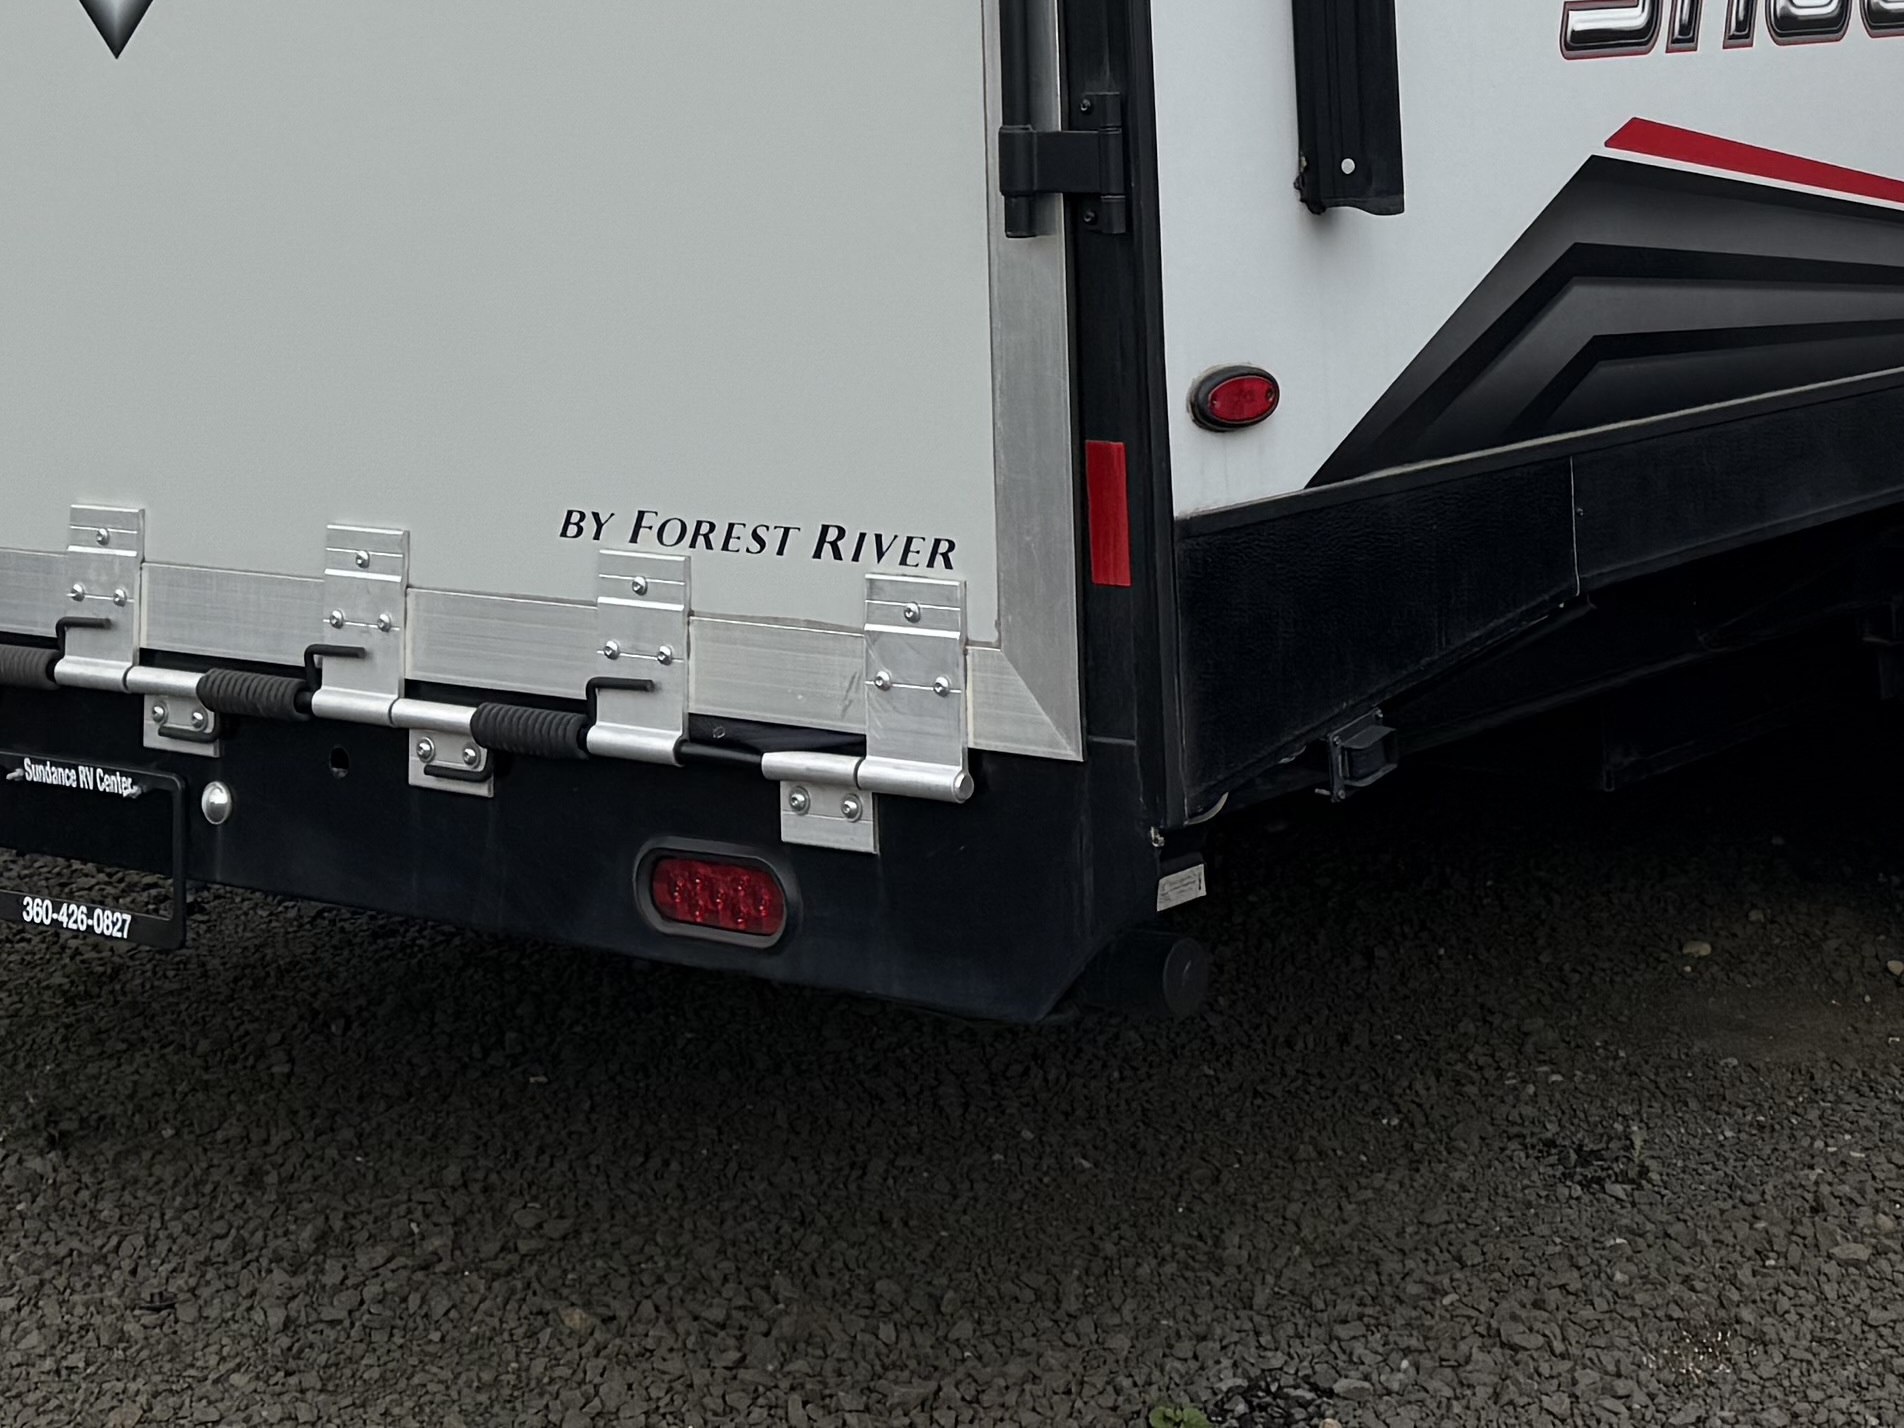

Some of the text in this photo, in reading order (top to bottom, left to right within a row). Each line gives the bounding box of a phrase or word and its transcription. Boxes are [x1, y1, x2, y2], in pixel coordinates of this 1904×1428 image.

[559, 509, 957, 571] BY FOREST RIVER
[24, 757, 132, 795] Sundance RV Center
[22, 896, 132, 939] 360-426-0827
